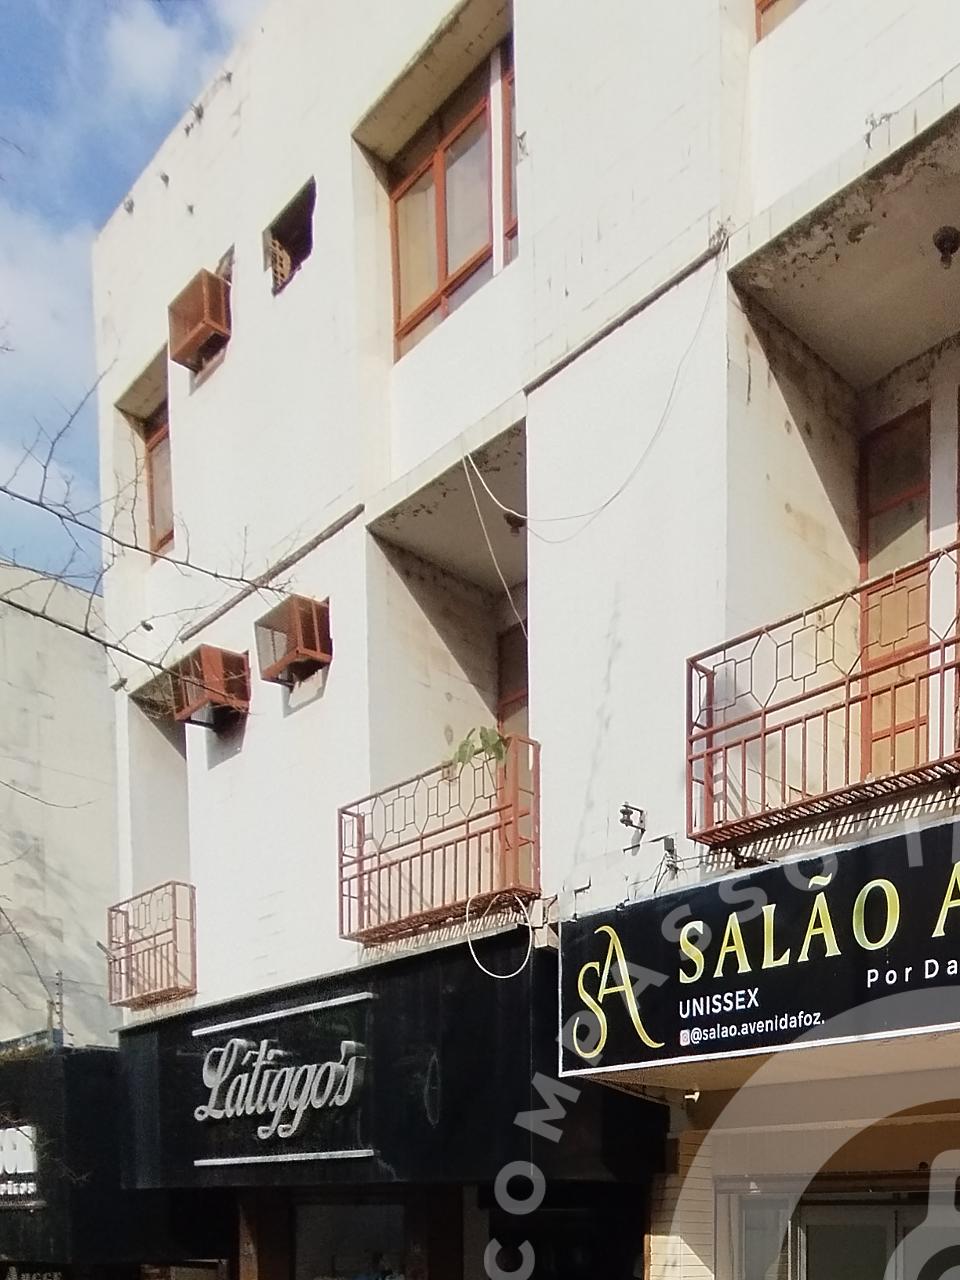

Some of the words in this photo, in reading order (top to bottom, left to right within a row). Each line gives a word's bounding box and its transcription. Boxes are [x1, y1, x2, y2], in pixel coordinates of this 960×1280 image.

[677, 872, 901, 985] SALÃO
[866, 965, 913, 989] Por
[678, 987, 760, 1019] UNISSEX
